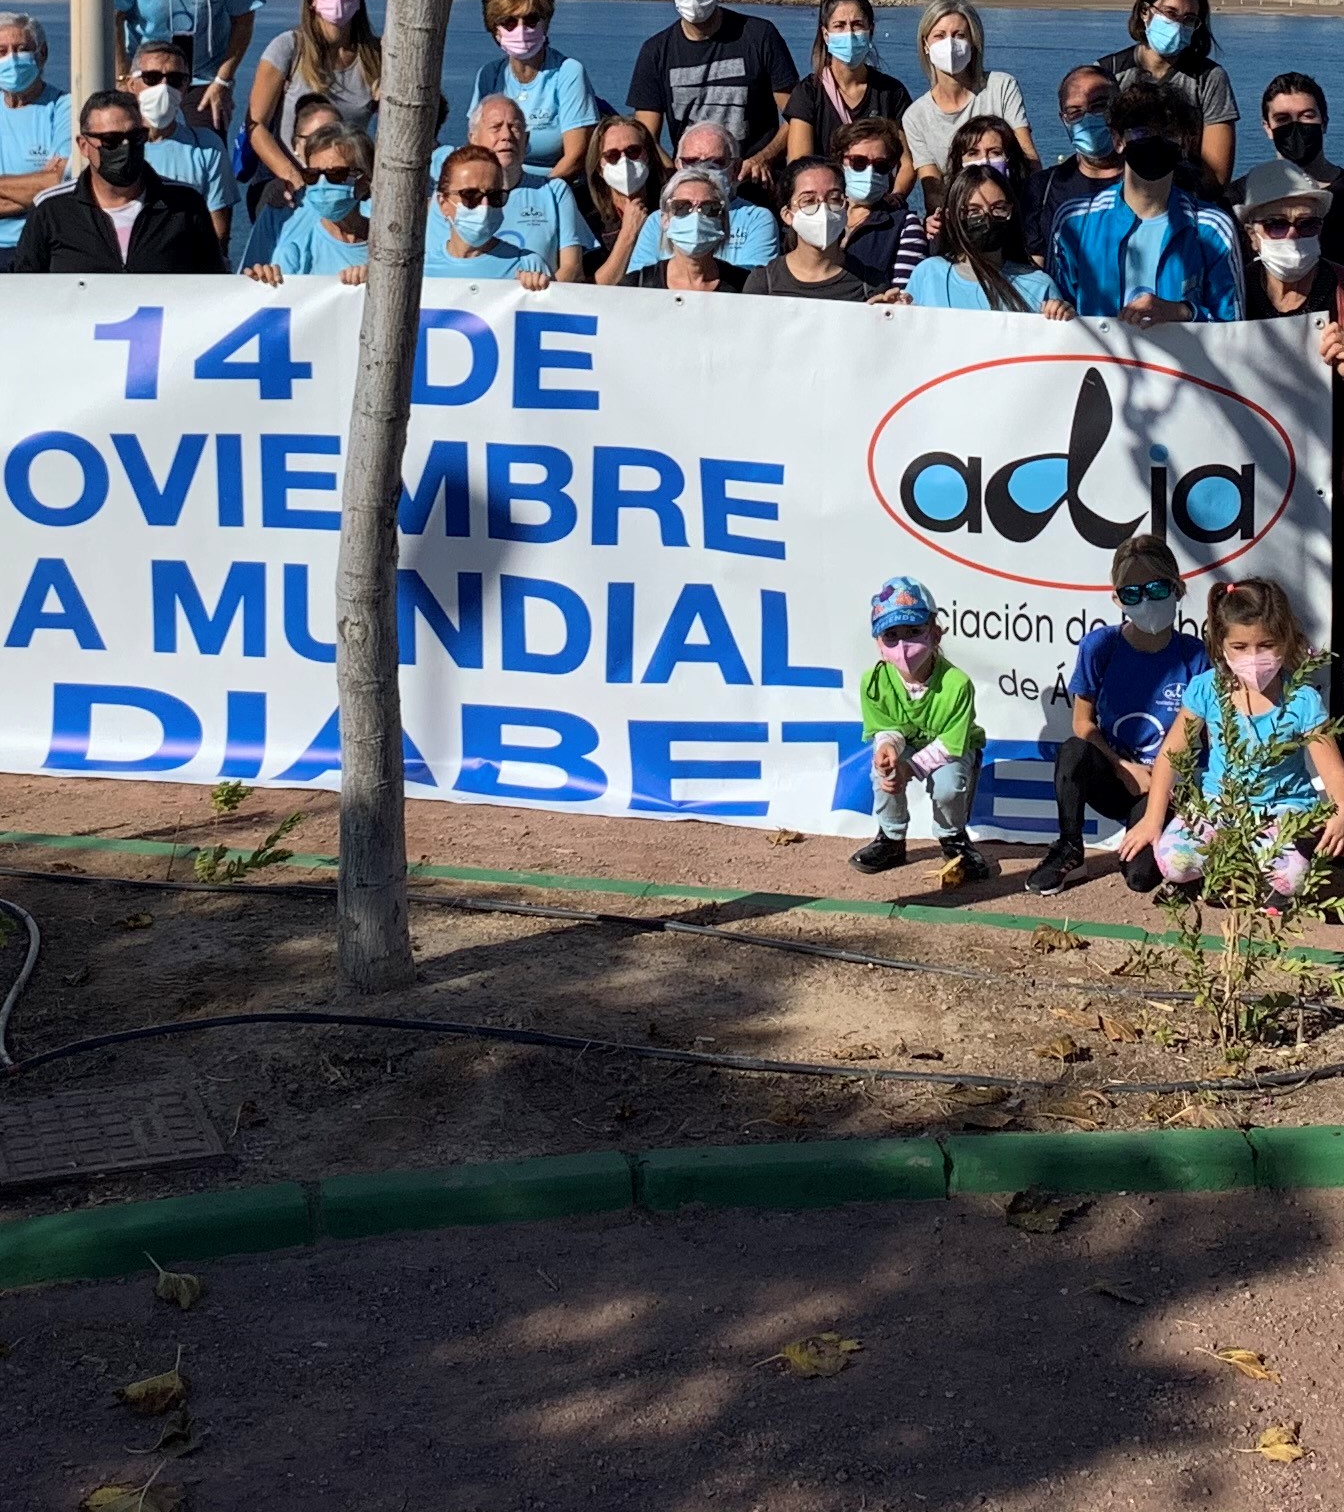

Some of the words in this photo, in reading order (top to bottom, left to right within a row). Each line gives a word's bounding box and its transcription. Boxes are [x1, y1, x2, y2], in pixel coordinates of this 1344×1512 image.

[93, 305, 312, 400] 14
[411, 308, 600, 410] DE
[152, 560, 844, 689] MUNDIAL
[937, 599, 1054, 644] ciación
[998, 669, 1039, 701] de
[42, 682, 1099, 836] DIABETE
